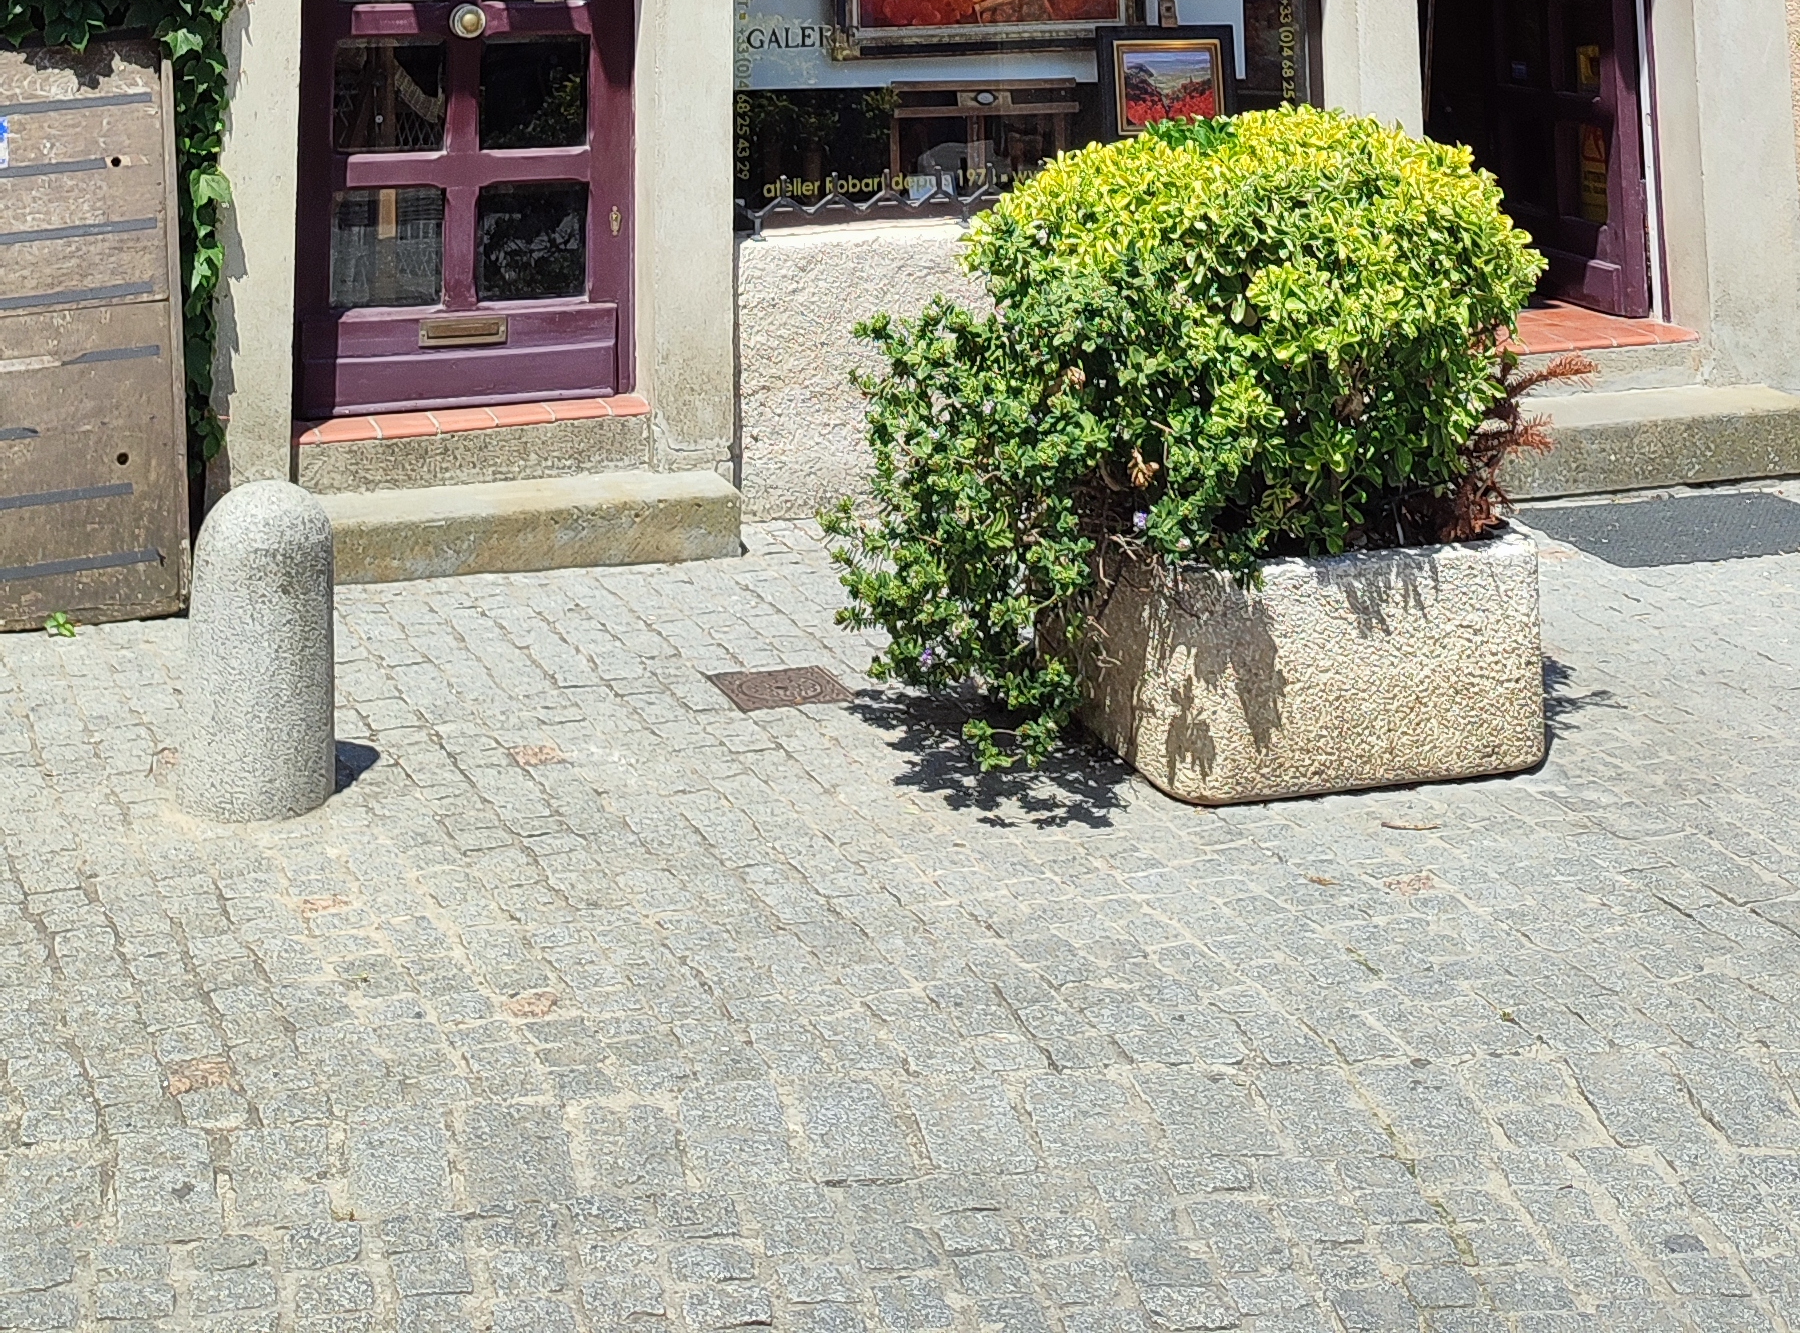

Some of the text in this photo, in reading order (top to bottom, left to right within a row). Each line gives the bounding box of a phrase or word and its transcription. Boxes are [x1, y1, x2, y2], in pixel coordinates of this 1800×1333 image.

[1278, 25, 1296, 58] (0)4
[736, 56, 752, 89] (0)4
[1281, 60, 1296, 78] 68
[1281, 81, 1296, 100] 25
[736, 92, 750, 113] 68
[736, 114, 750, 135] 25
[736, 137, 750, 158] 43
[736, 159, 750, 180] 29
[763, 177, 821, 198] atelier
